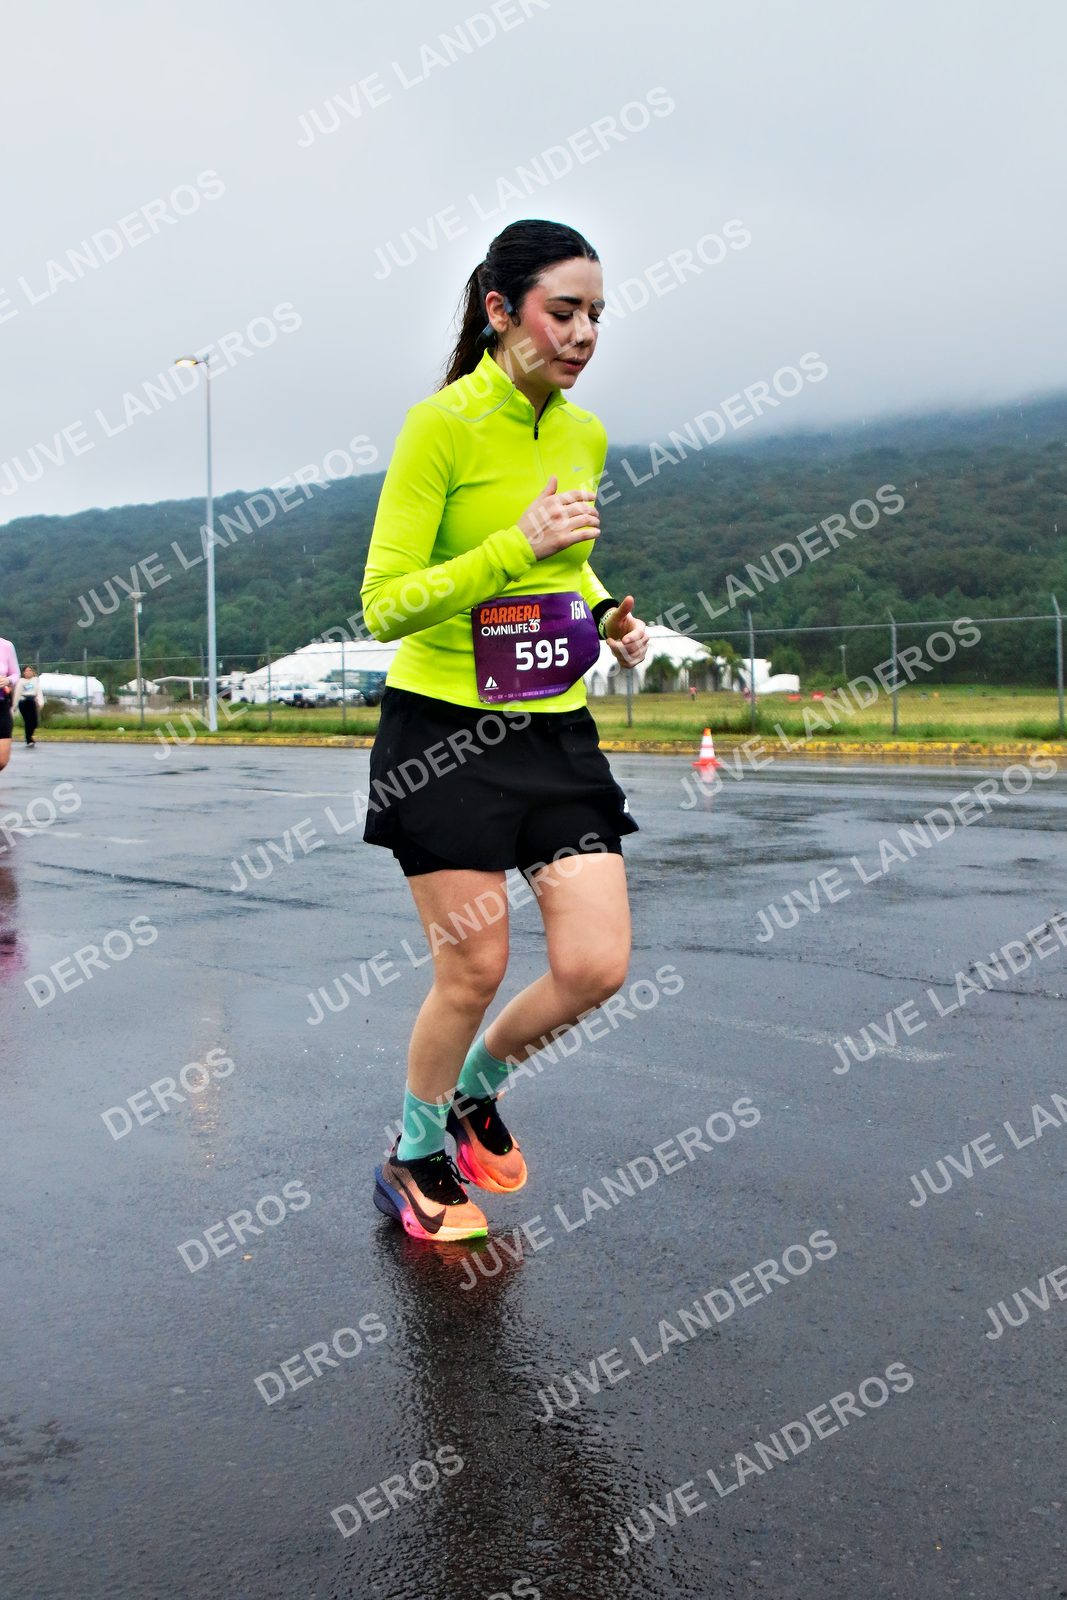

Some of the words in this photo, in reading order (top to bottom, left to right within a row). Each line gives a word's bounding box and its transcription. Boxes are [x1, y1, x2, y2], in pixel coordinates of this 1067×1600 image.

[480, 604, 541, 625] CARRERA
[570, 600, 587, 620] 15K
[481, 623, 528, 637] OMNILIFE
[515, 637, 570, 671] 595
